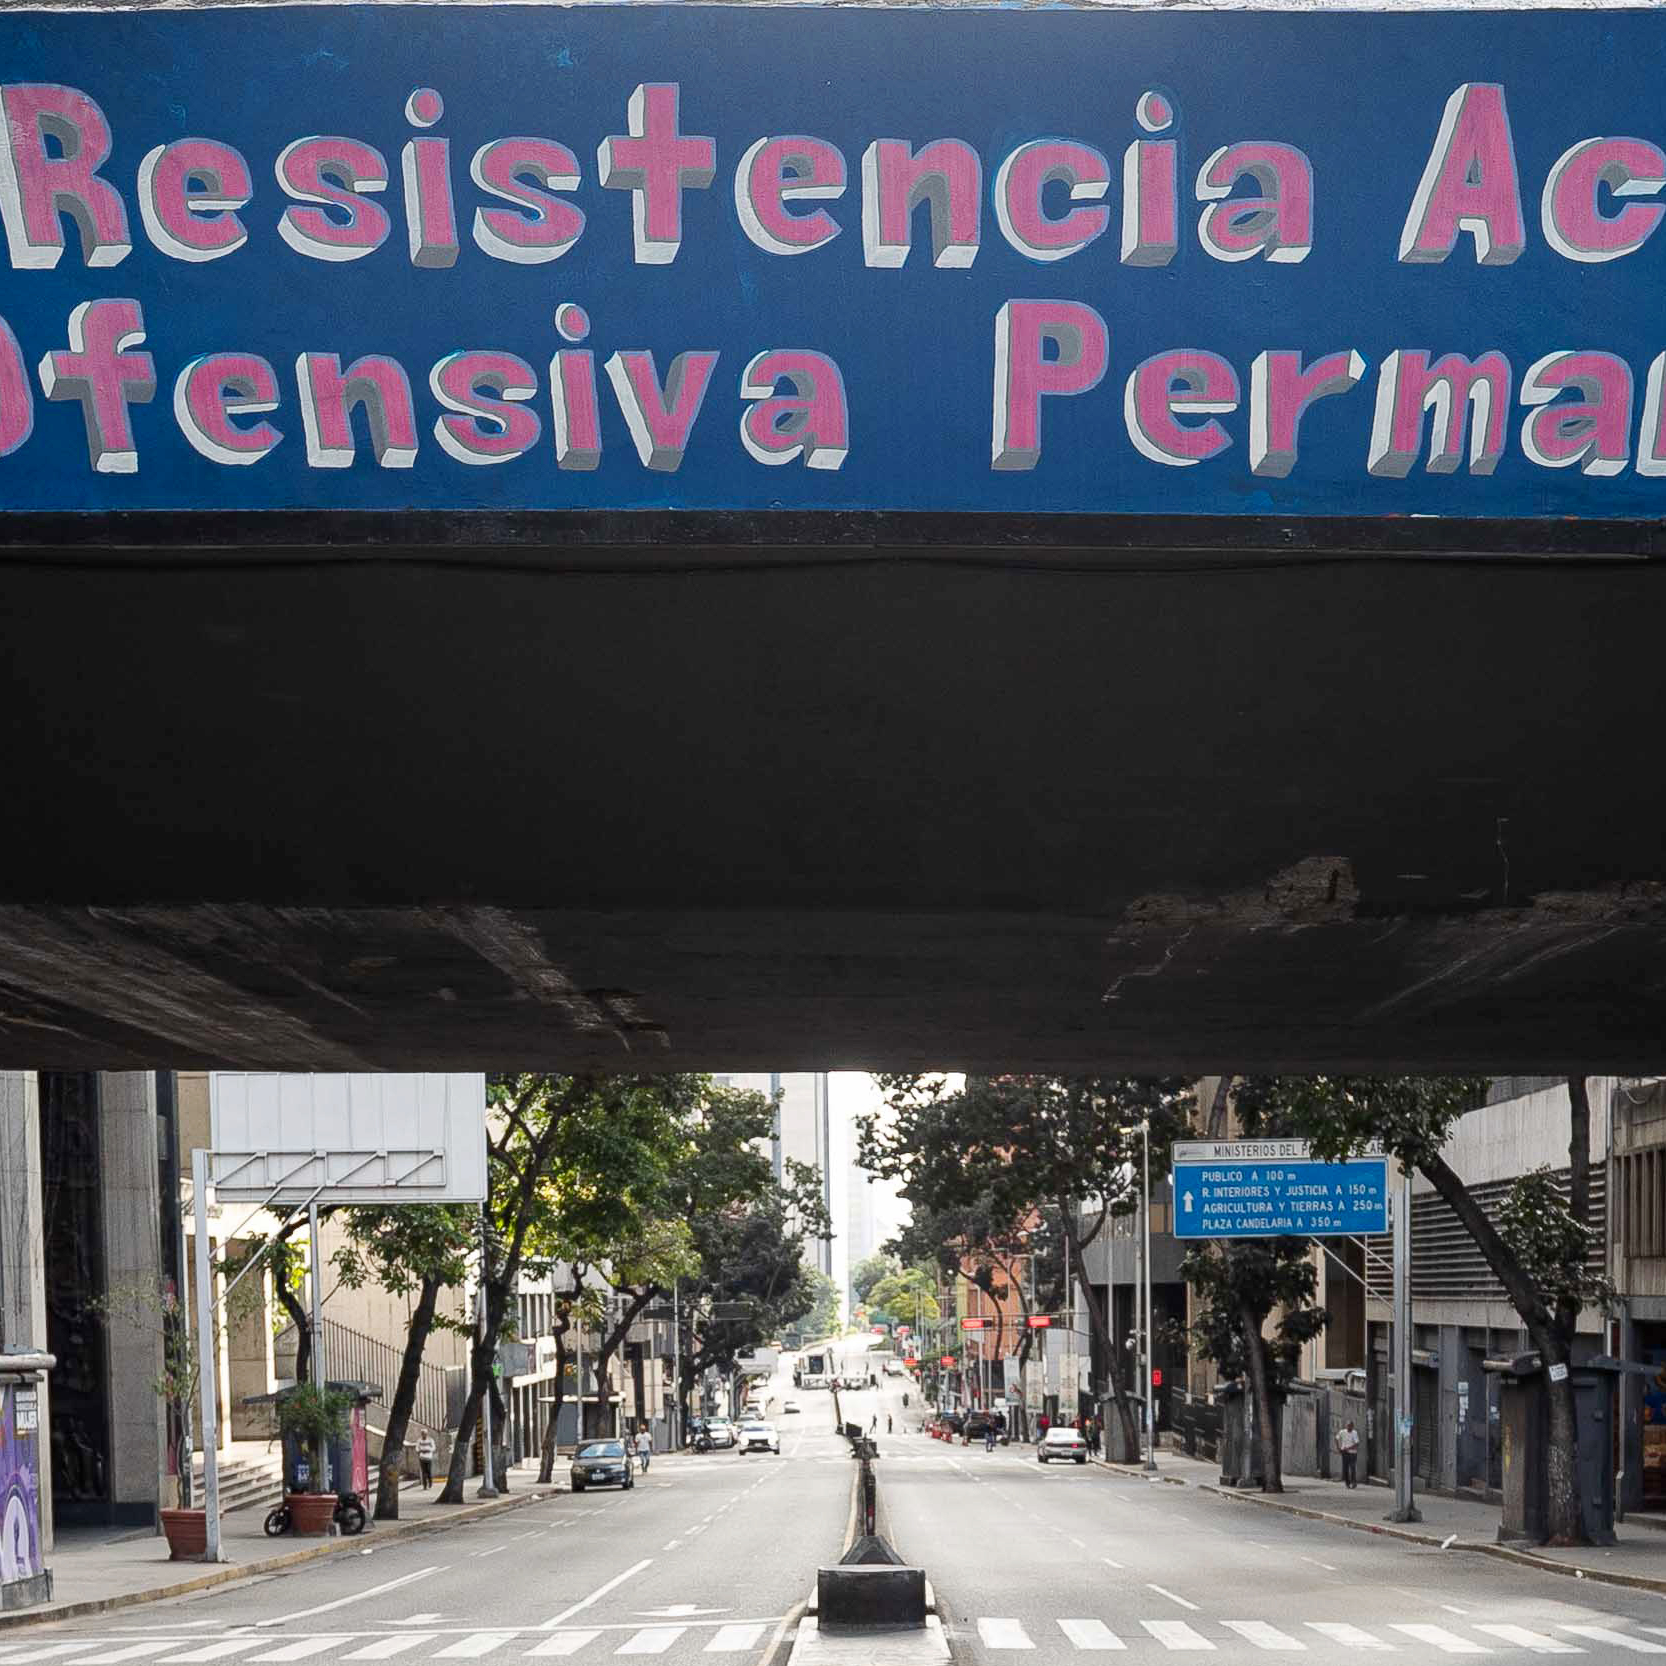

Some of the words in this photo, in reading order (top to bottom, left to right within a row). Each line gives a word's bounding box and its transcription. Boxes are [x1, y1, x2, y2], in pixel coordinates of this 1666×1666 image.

[1214, 1144, 1276, 1157] MINISTERIOS
[1279, 1143, 1298, 1156] DEL
[1201, 1171, 1243, 1182] PUBLICO
[1251, 1171, 1259, 1181] A
[1266, 1170, 1284, 1181] 100
[1287, 1173, 1296, 1181] m
[1213, 1186, 1270, 1198] INTERIORES
[1274, 1186, 1281, 1196] Y
[1285, 1185, 1329, 1196] JUSTICIA
[1335, 1184, 1343, 1195] A
[1349, 1183, 1366, 1194] 150
[1368, 1186, 1377, 1195] m
[1203, 1202, 1274, 1213] AGRICULTURA
[1278, 1201, 1285, 1212] Y
[1290, 1200, 1334, 1212] TIERRAS
[1338, 1200, 1345, 1211] A
[1353, 1199, 1373, 1211] 250
[1374, 1202, 1383, 1210] m
[1201, 1218, 1233, 1230] PLAZA
[1236, 1217, 1293, 1229] CANDELARIA
[1296, 1217, 1303, 1228] A
[1310, 1216, 1331, 1227] 350
[1333, 1219, 1341, 1227] m
